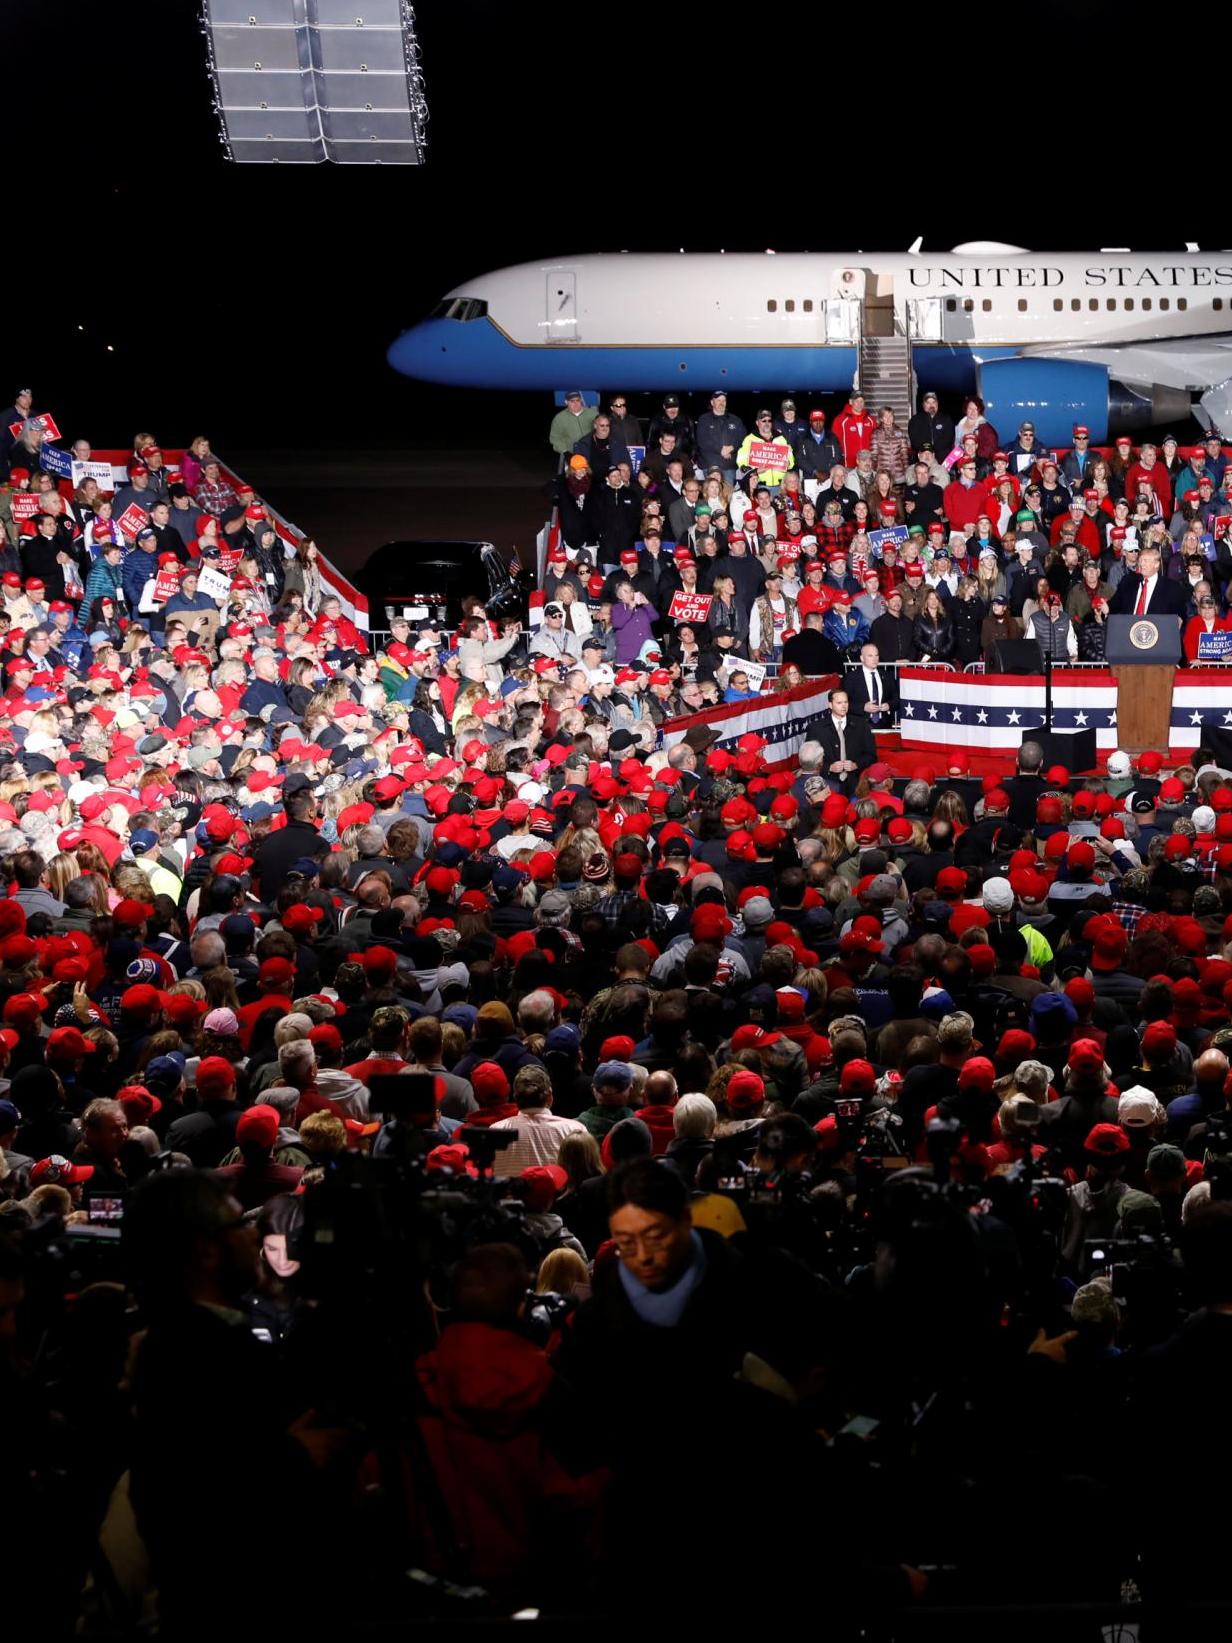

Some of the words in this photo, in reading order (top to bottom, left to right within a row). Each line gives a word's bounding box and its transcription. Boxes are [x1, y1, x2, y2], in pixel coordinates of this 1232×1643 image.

[907, 267, 1065, 288] UNITED
[41, 452, 72, 470] AMERICA
[750, 450, 787, 461] AMERICA
[675, 593, 694, 603] GET
[694, 596, 711, 604] OUT
[674, 606, 706, 620] VOTE
